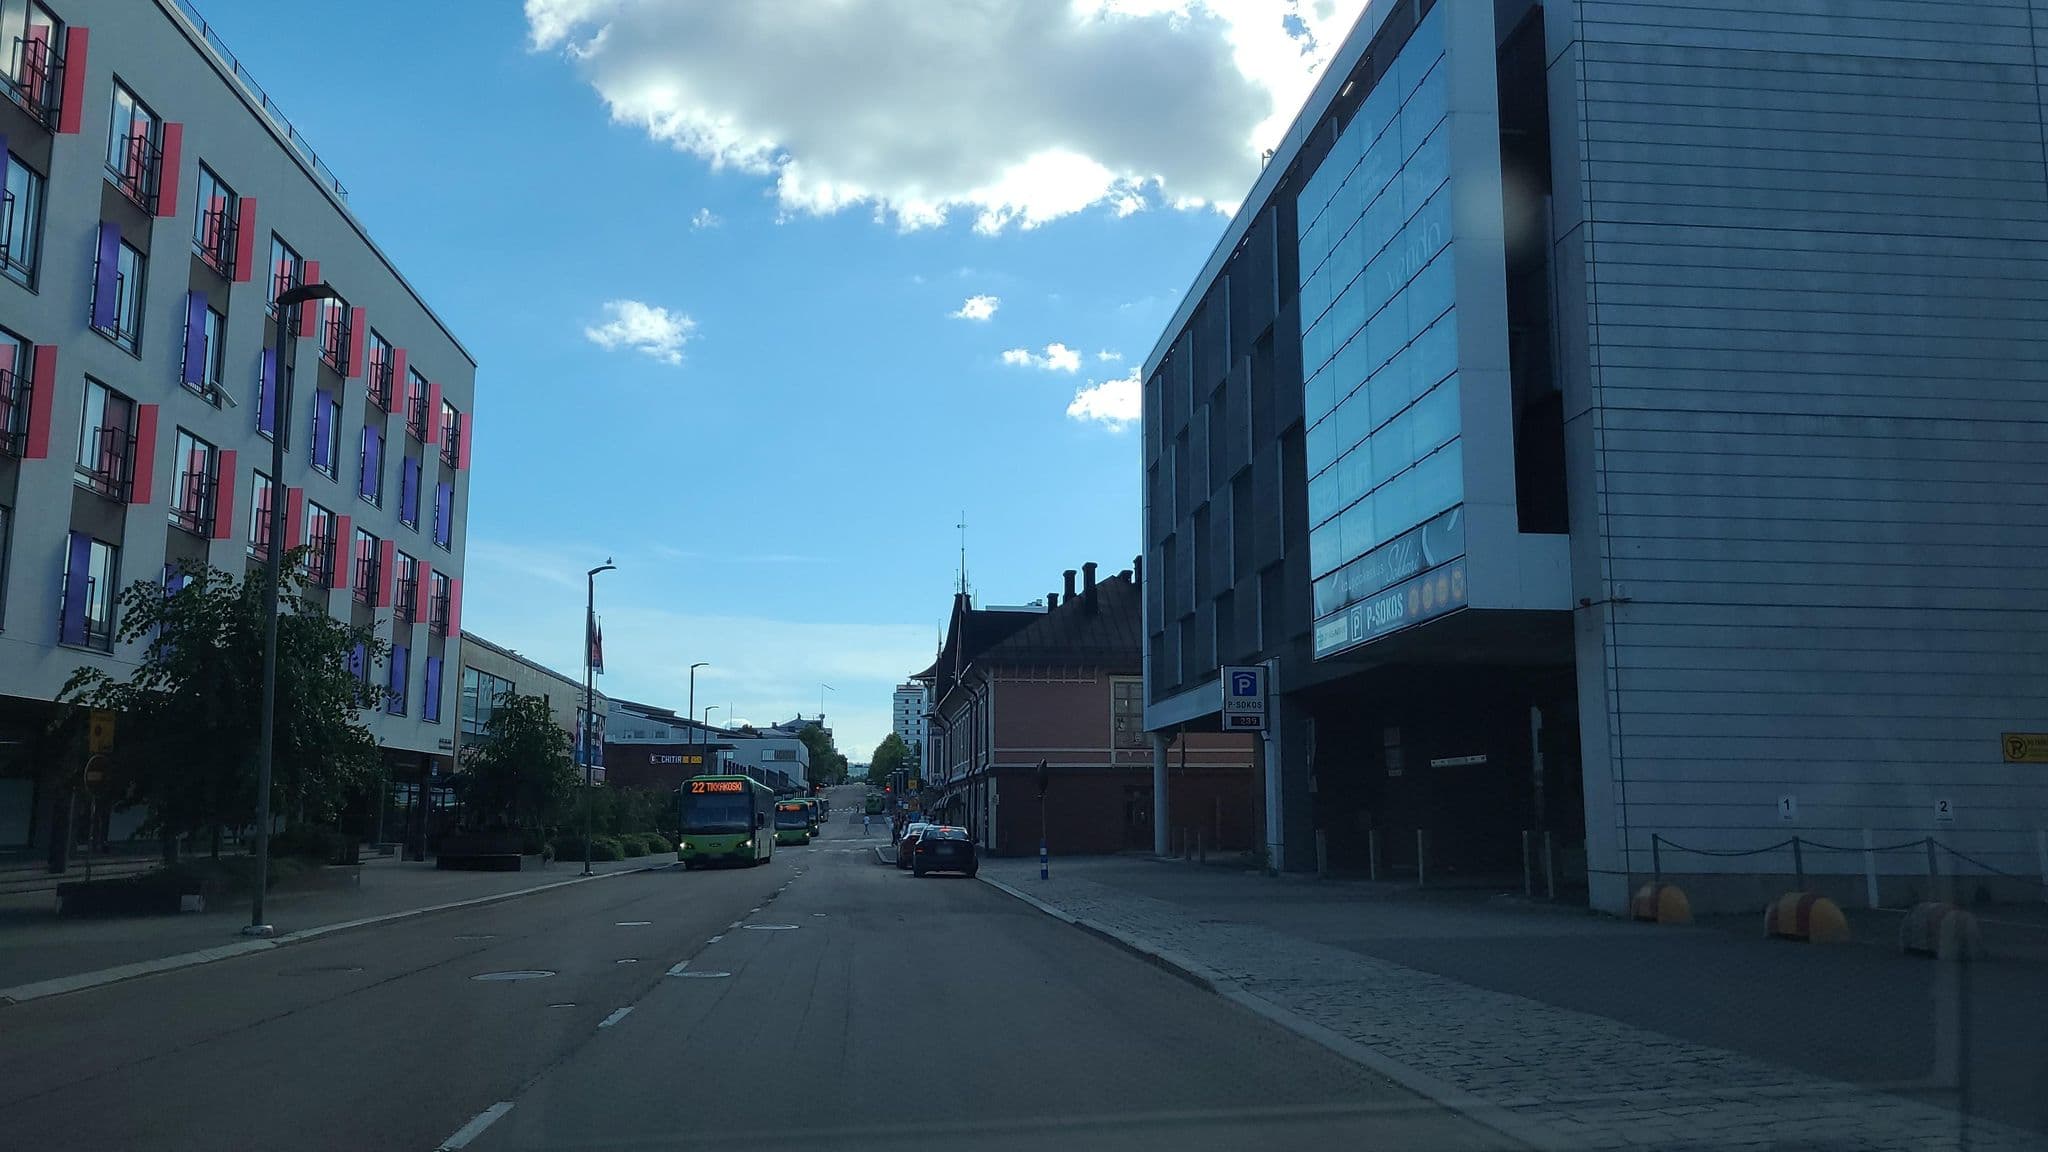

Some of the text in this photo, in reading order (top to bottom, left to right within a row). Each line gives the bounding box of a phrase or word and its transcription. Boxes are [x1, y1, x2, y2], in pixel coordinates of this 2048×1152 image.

[1366, 592, 1403, 630] P-SOKOS
[1228, 701, 1262, 709] P-SOKOS
[692, 781, 705, 793] 22
[1784, 798, 1790, 811] 1
[1939, 801, 1948, 813] 2
